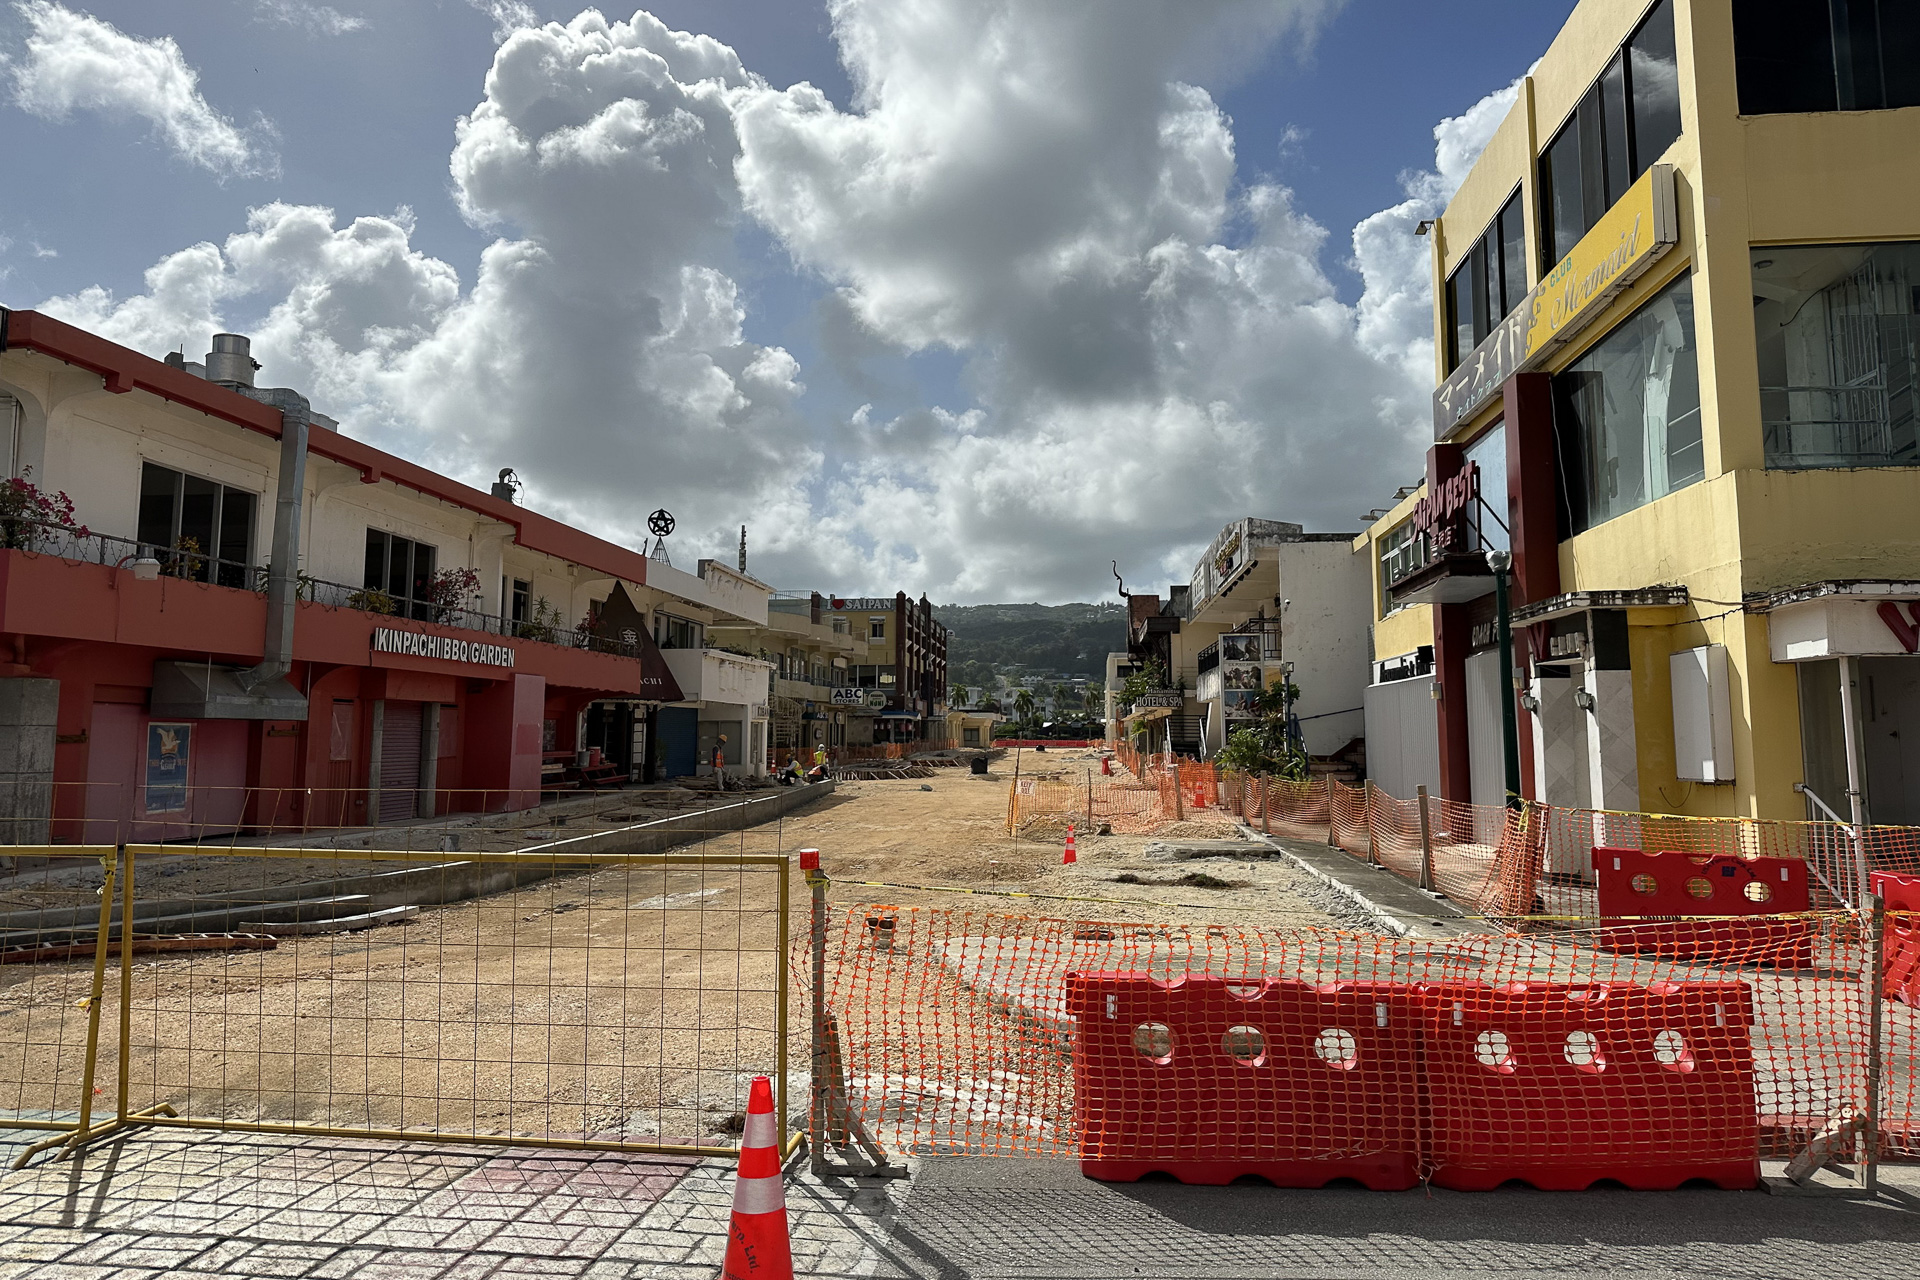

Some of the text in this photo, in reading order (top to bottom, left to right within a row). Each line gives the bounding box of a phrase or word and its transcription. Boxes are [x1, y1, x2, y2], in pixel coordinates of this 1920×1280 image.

[1550, 212, 1641, 330] Mermaid
[1550, 256, 1572, 287] CLUB
[1438, 310, 1524, 411] マーメイド
[1445, 462, 1473, 519] BEST
[826, 599, 892, 610] I SAIPAN
[443, 637, 468, 663] BBQ
[471, 642, 515, 667] GARDEN
[833, 688, 862, 698] ABC
[1136, 696, 1183, 707] HOTEL & SPA
[744, 1244, 760, 1274] Ltd.
